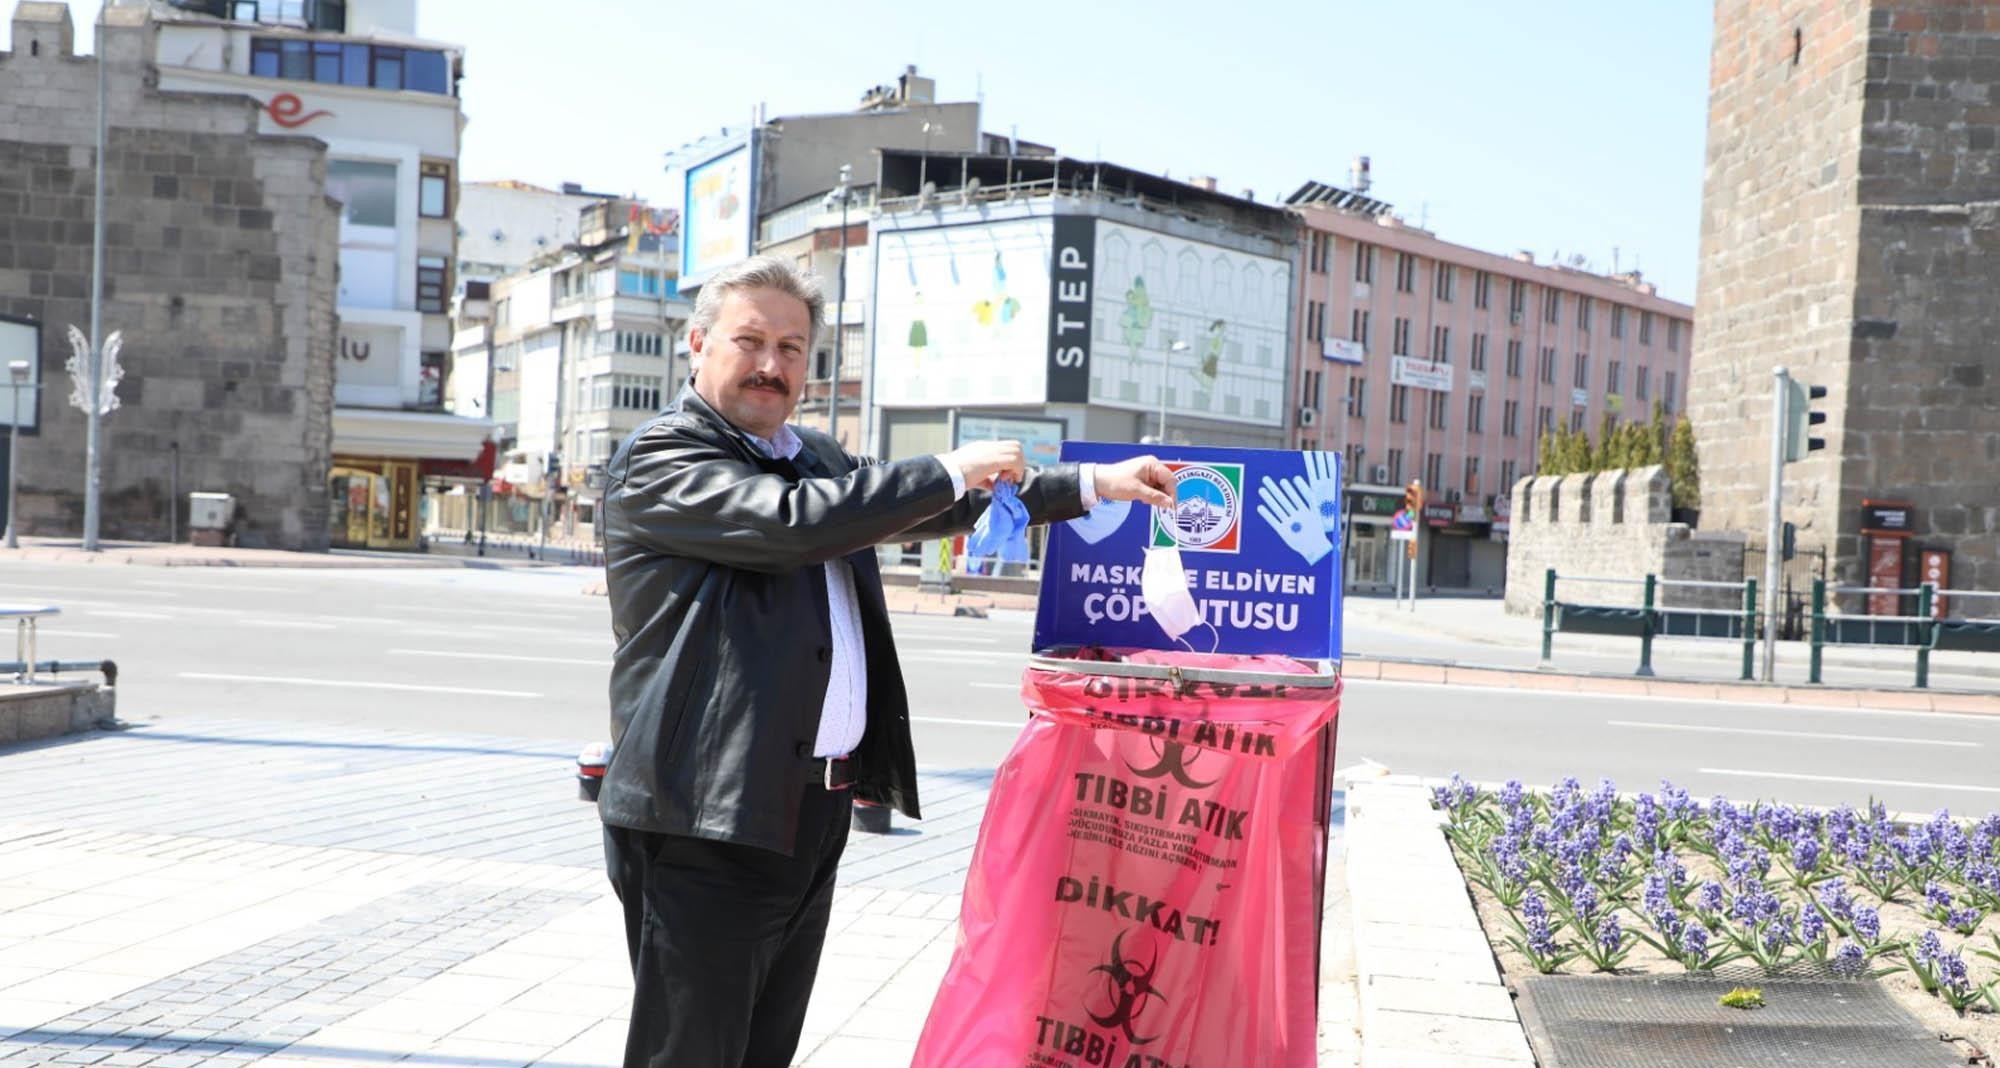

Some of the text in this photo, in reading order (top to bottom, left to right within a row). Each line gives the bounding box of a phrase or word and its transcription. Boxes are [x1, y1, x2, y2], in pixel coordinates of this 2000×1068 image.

[1056, 246, 1087, 368] STEP
[1071, 563, 1143, 586] MASK
[1206, 568, 1315, 595] ELDİVEN
[1083, 588, 1299, 631] ÇÖP TUSU
[1075, 772, 1249, 841] TIBBİ ATIK
[1138, 834, 1169, 850] FAZLA
[1055, 875, 1221, 946] DİKKAT!
